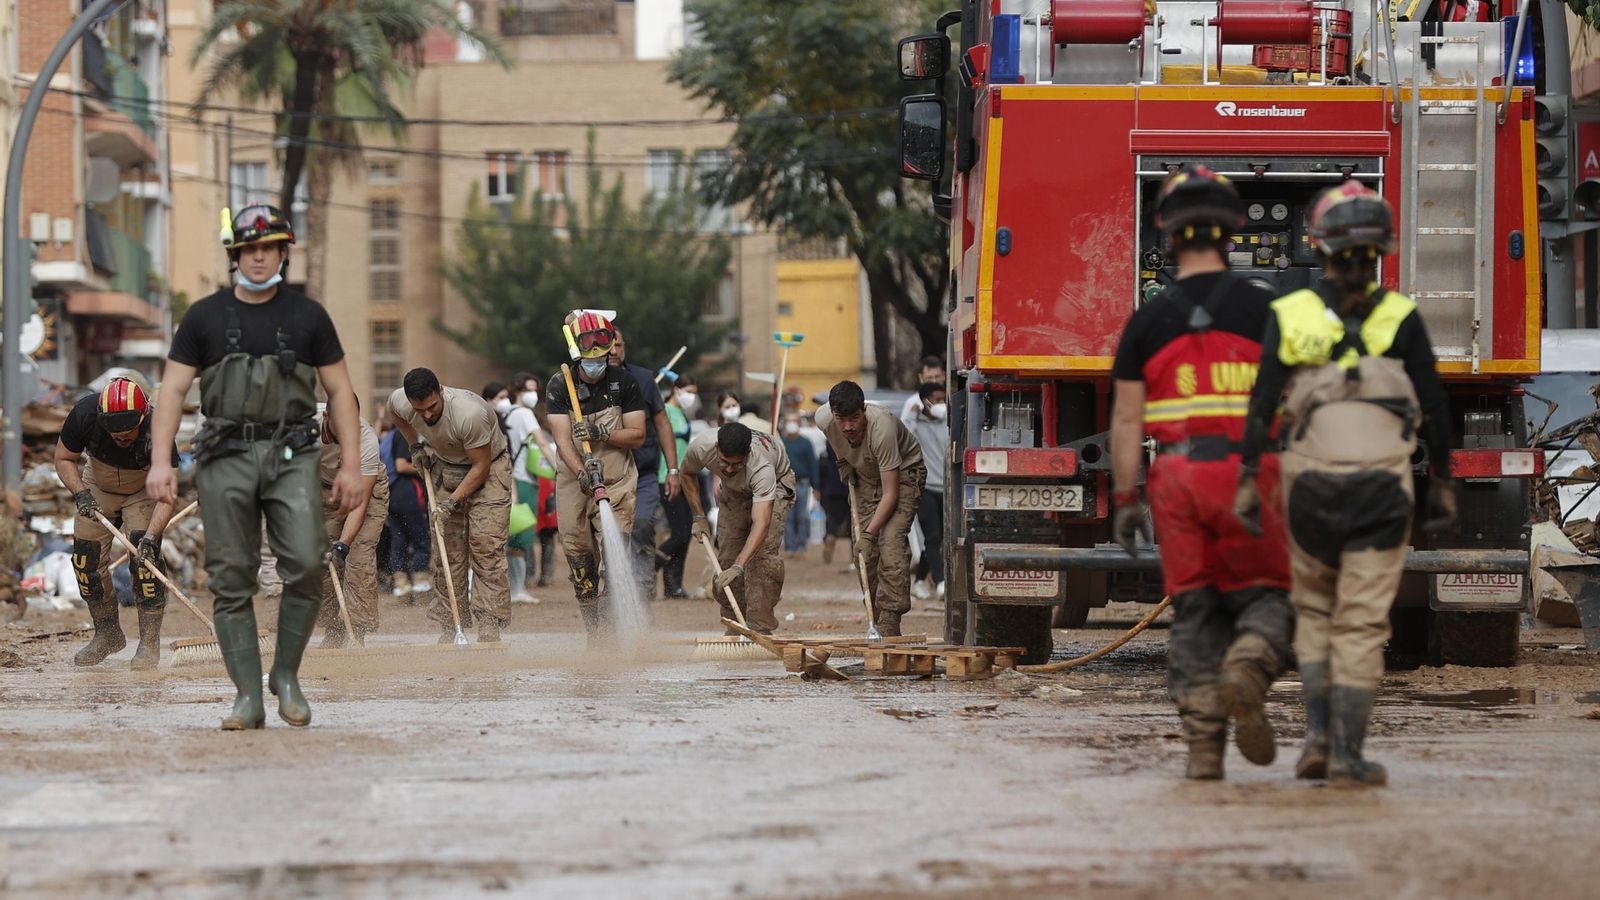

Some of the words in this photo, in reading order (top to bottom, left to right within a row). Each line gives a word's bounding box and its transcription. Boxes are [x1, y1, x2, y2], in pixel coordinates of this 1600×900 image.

[1238, 105, 1307, 116] rosenbauer
[979, 488, 1001, 506] ET
[1009, 488, 1077, 507] 120932
